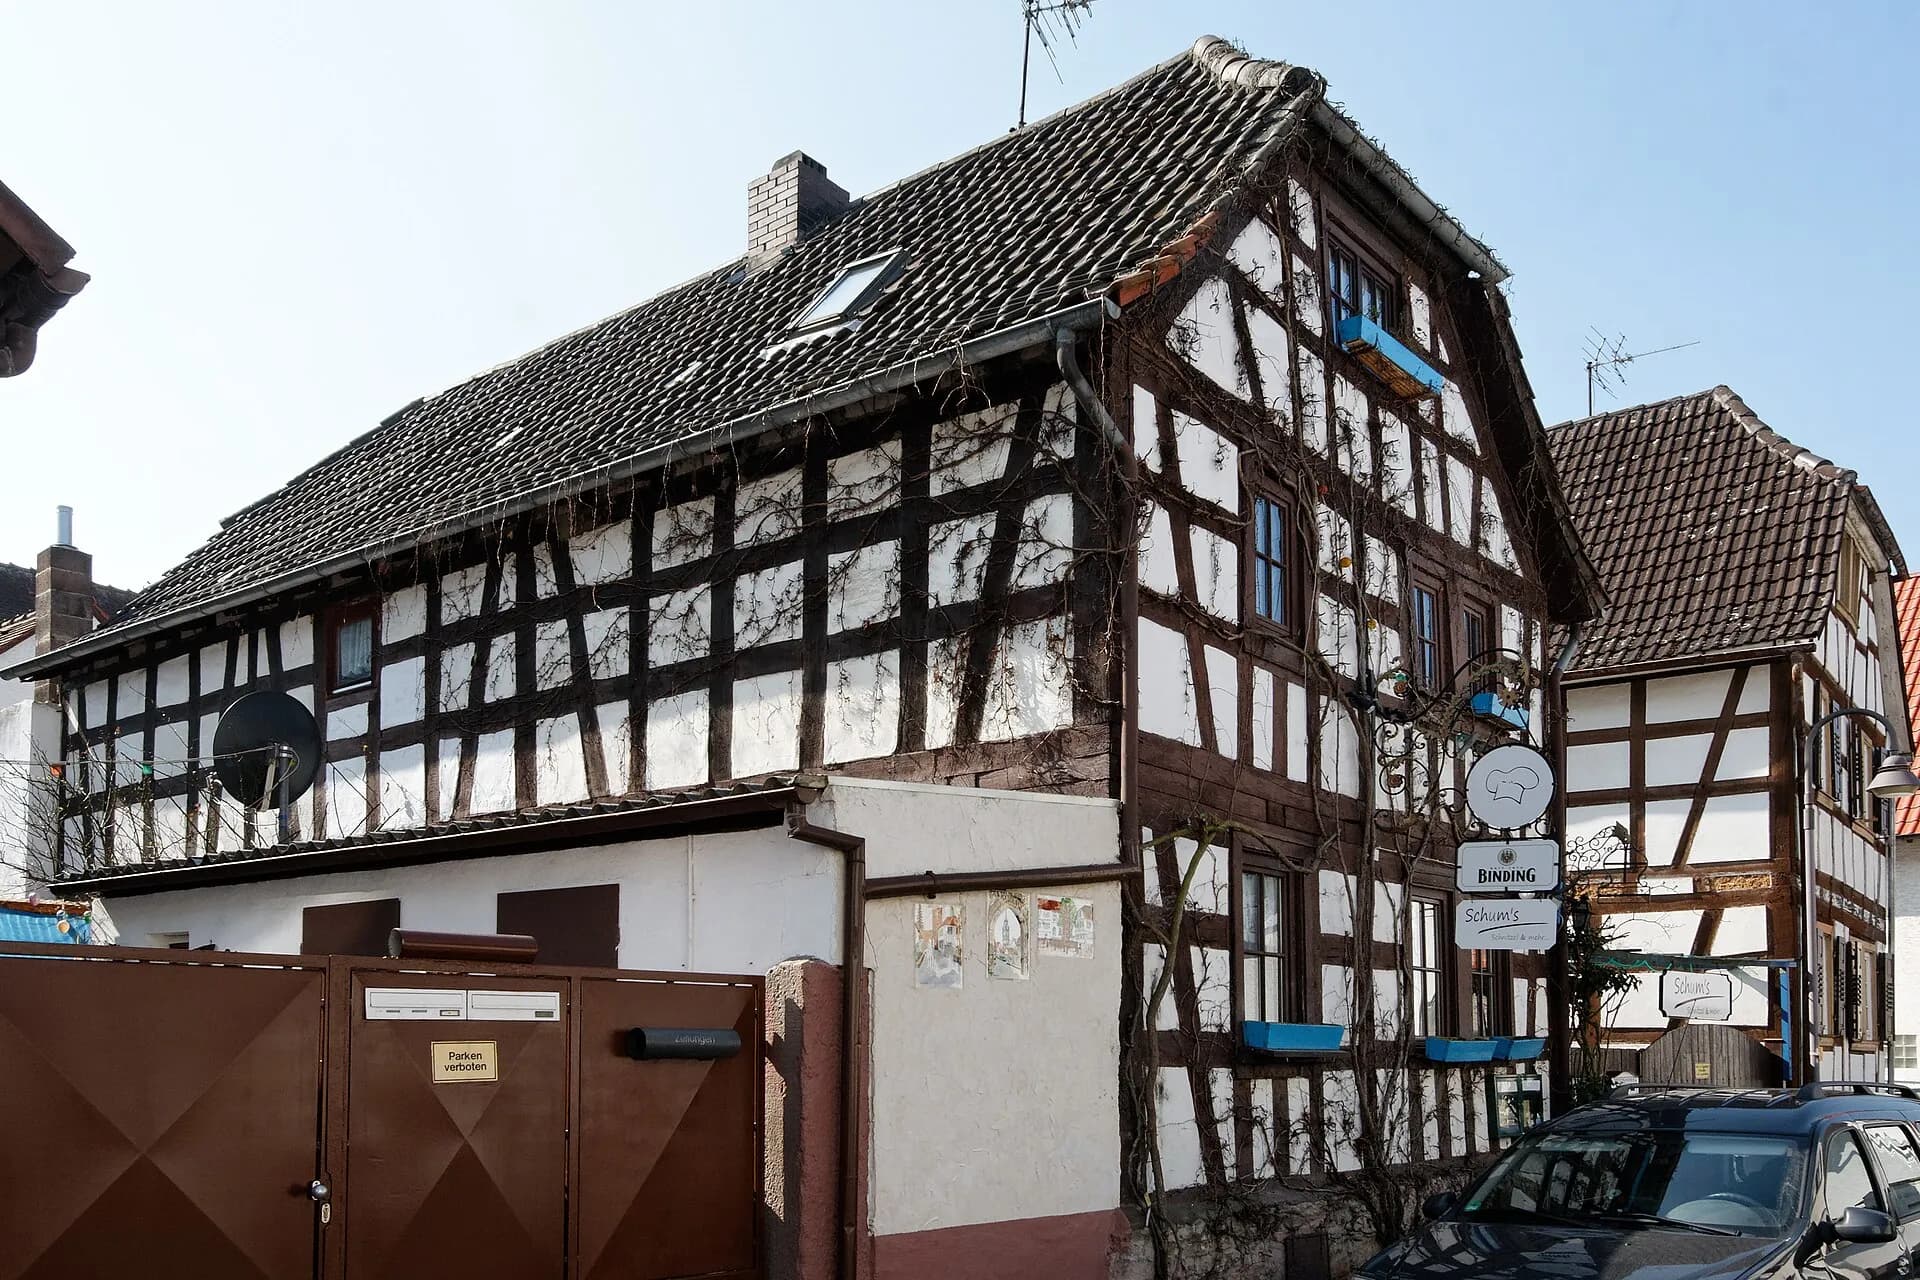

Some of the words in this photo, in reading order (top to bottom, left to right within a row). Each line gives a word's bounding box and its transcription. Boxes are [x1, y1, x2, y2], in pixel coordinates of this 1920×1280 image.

[1478, 867, 1536, 883] BINDING
[1465, 907, 1519, 923] Schum's
[1520, 932, 1526, 941] &
[1674, 976, 1710, 995] Schum's
[448, 1051, 483, 1061] Parken
[444, 1062, 487, 1072] verboten
